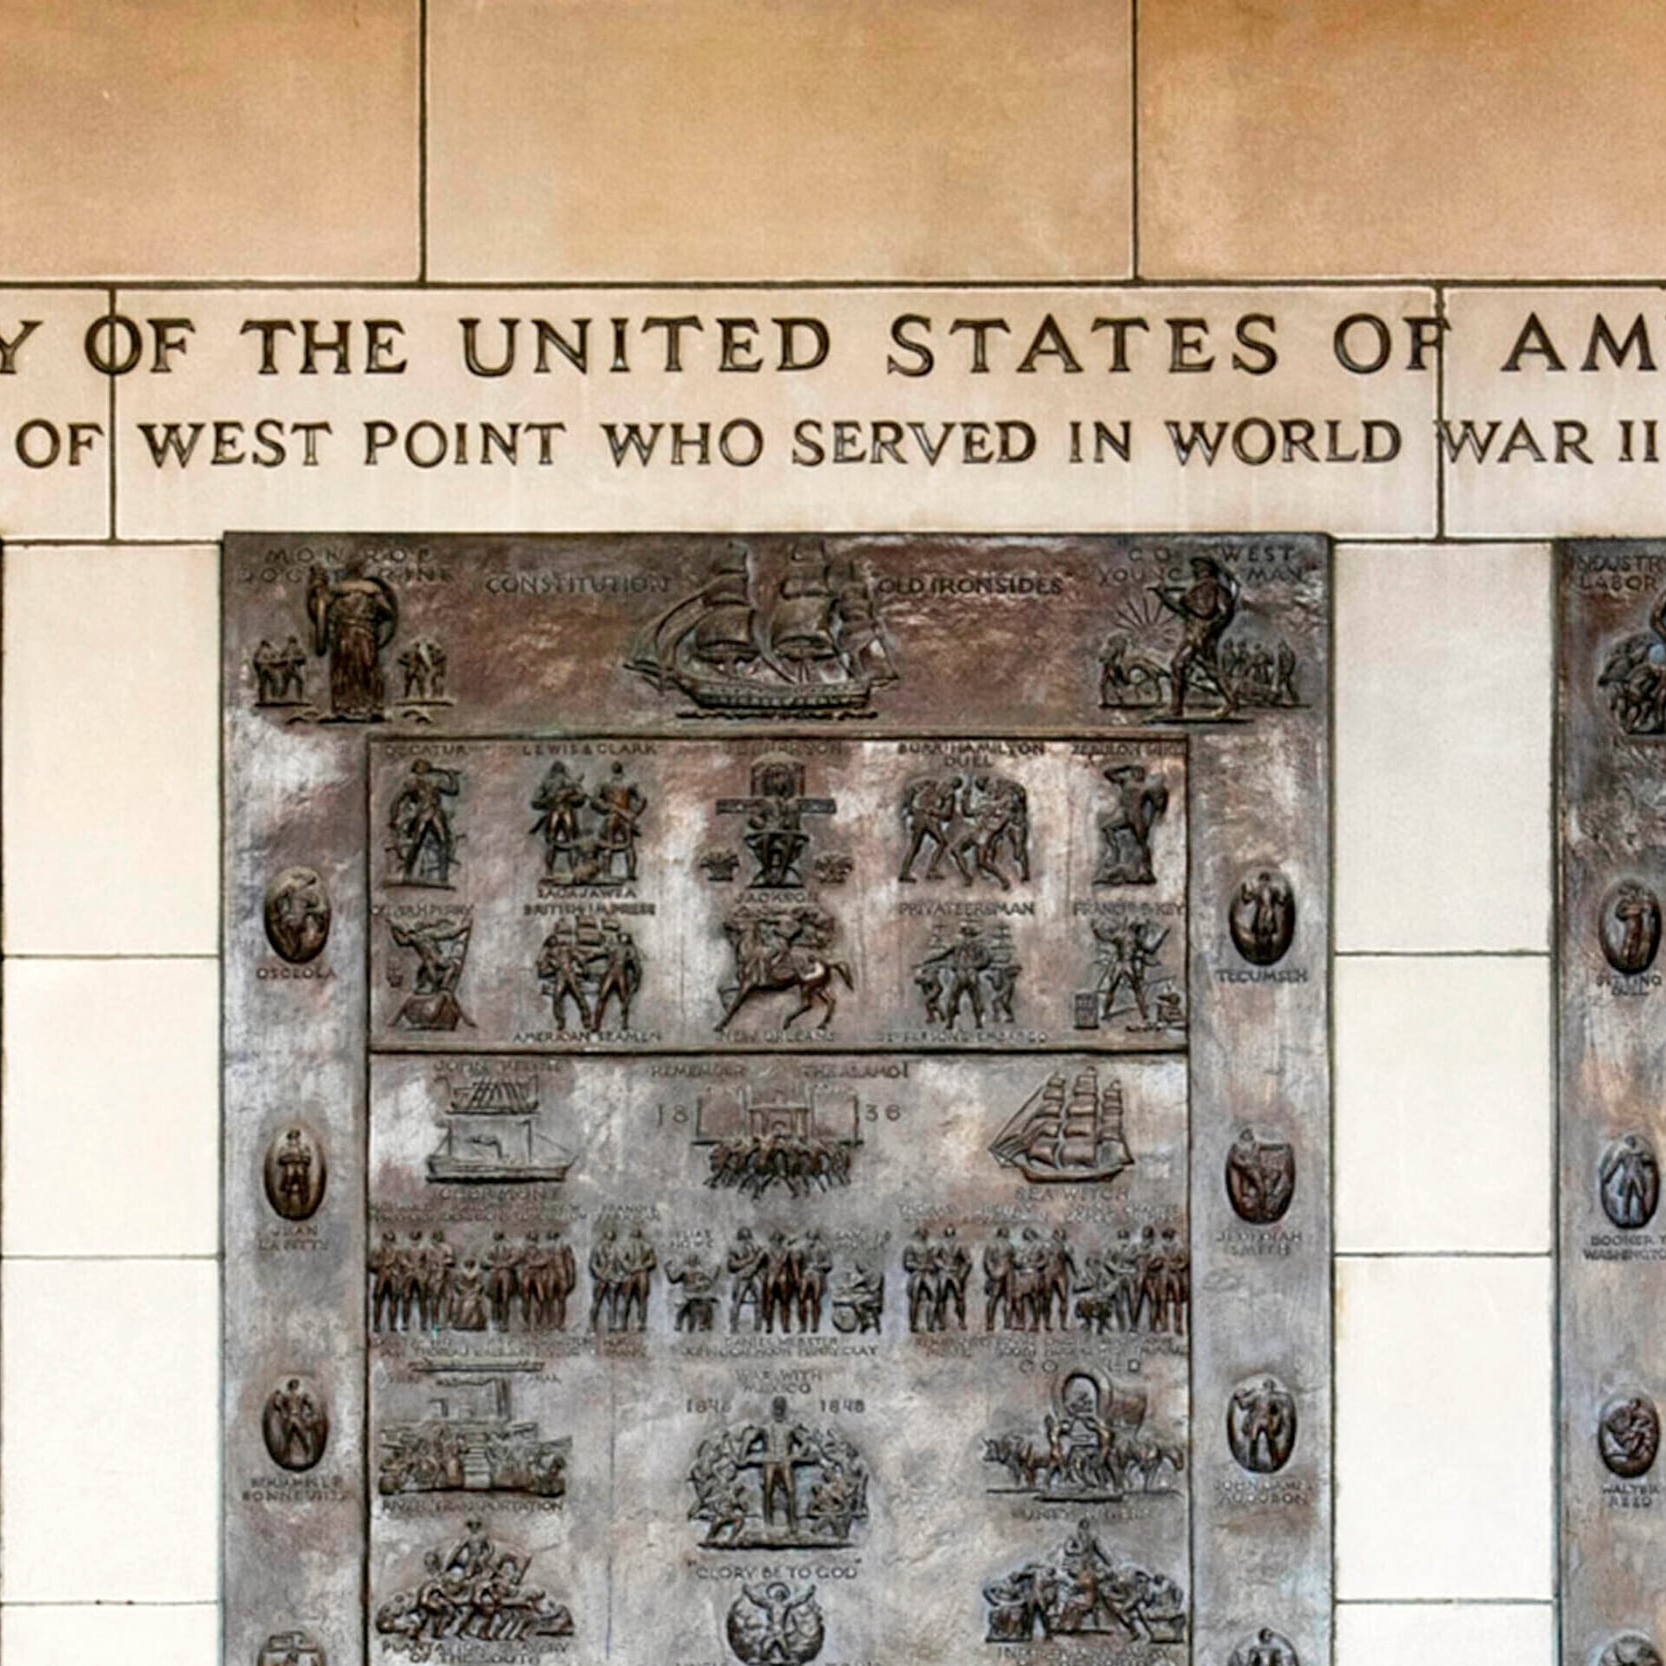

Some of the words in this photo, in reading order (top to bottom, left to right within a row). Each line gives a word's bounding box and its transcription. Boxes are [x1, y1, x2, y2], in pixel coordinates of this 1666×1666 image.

[83, 316, 195, 377] OF
[239, 318, 408, 376] THE
[457, 315, 831, 379] UNITED
[887, 313, 1279, 378] STATES
[1333, 314, 1451, 376] OF
[14, 417, 103, 468] OF
[138, 419, 333, 468] WEST
[362, 419, 567, 469] POINT
[599, 417, 765, 468] WHO
[791, 418, 1037, 468] SERVED
[1069, 420, 1132, 464] IN
[1163, 416, 1403, 467] WORLD
[1437, 417, 1594, 464] WAR
[1618, 419, 1660, 464] II
[1221, 545, 1296, 562] WEST
[485, 575, 671, 594] CONSTITUTION
[878, 577, 924, 595] OLD
[930, 576, 1066, 596] IRONSIDES
[1579, 575, 1658, 593] LABOR
[1216, 970, 1309, 984] TECUMSEH
[657, 1103, 690, 1125] 18
[865, 1103, 902, 1123] 36
[819, 1398, 865, 1413] 1848
